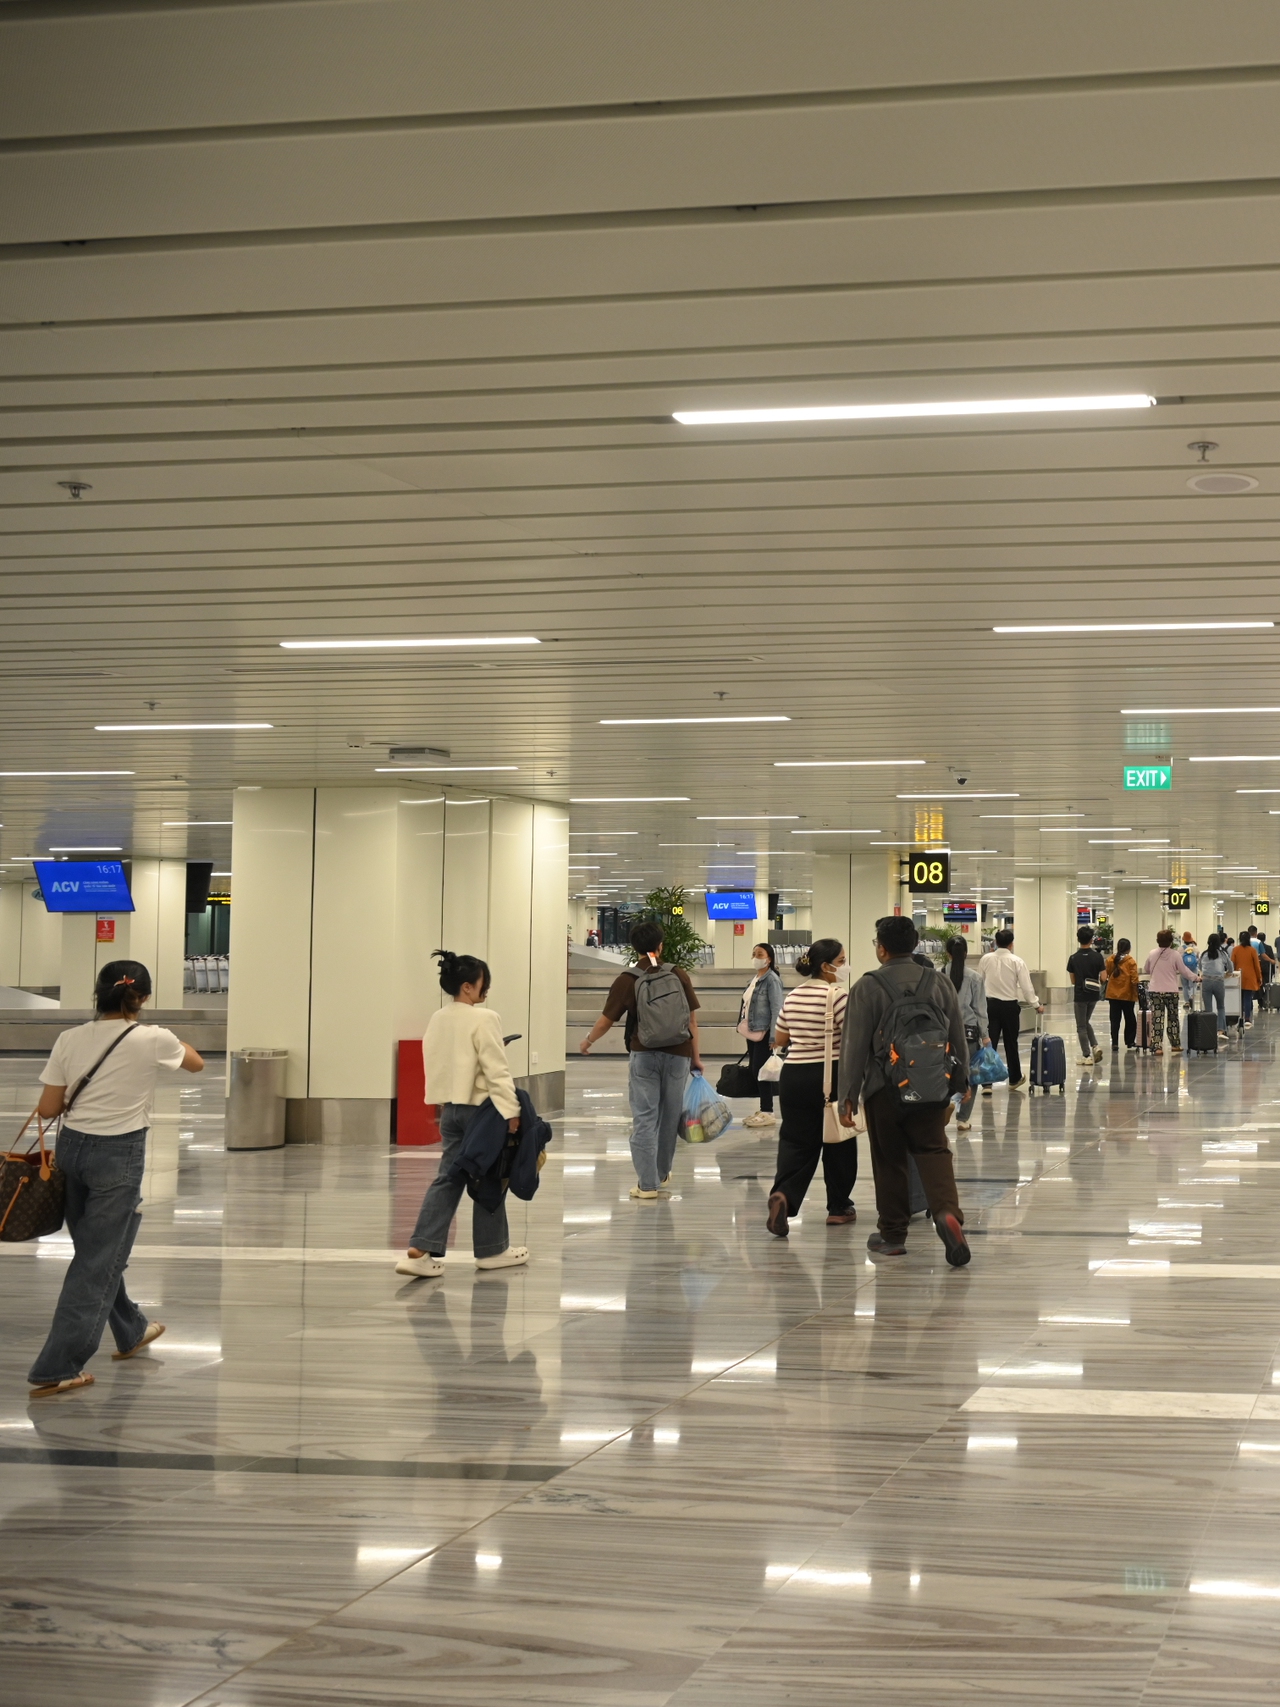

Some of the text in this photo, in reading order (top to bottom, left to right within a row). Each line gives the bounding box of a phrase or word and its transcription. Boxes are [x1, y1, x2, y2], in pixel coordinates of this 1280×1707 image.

[1126, 769, 1158, 787] EXIT
[96, 864, 122, 874] 16:17
[913, 861, 943, 884] 08
[51, 881, 80, 893] ACV
[1170, 892, 1187, 905] 07
[672, 906, 684, 915] 06
[712, 902, 730, 910] ACV
[1256, 903, 1268, 913] 06
